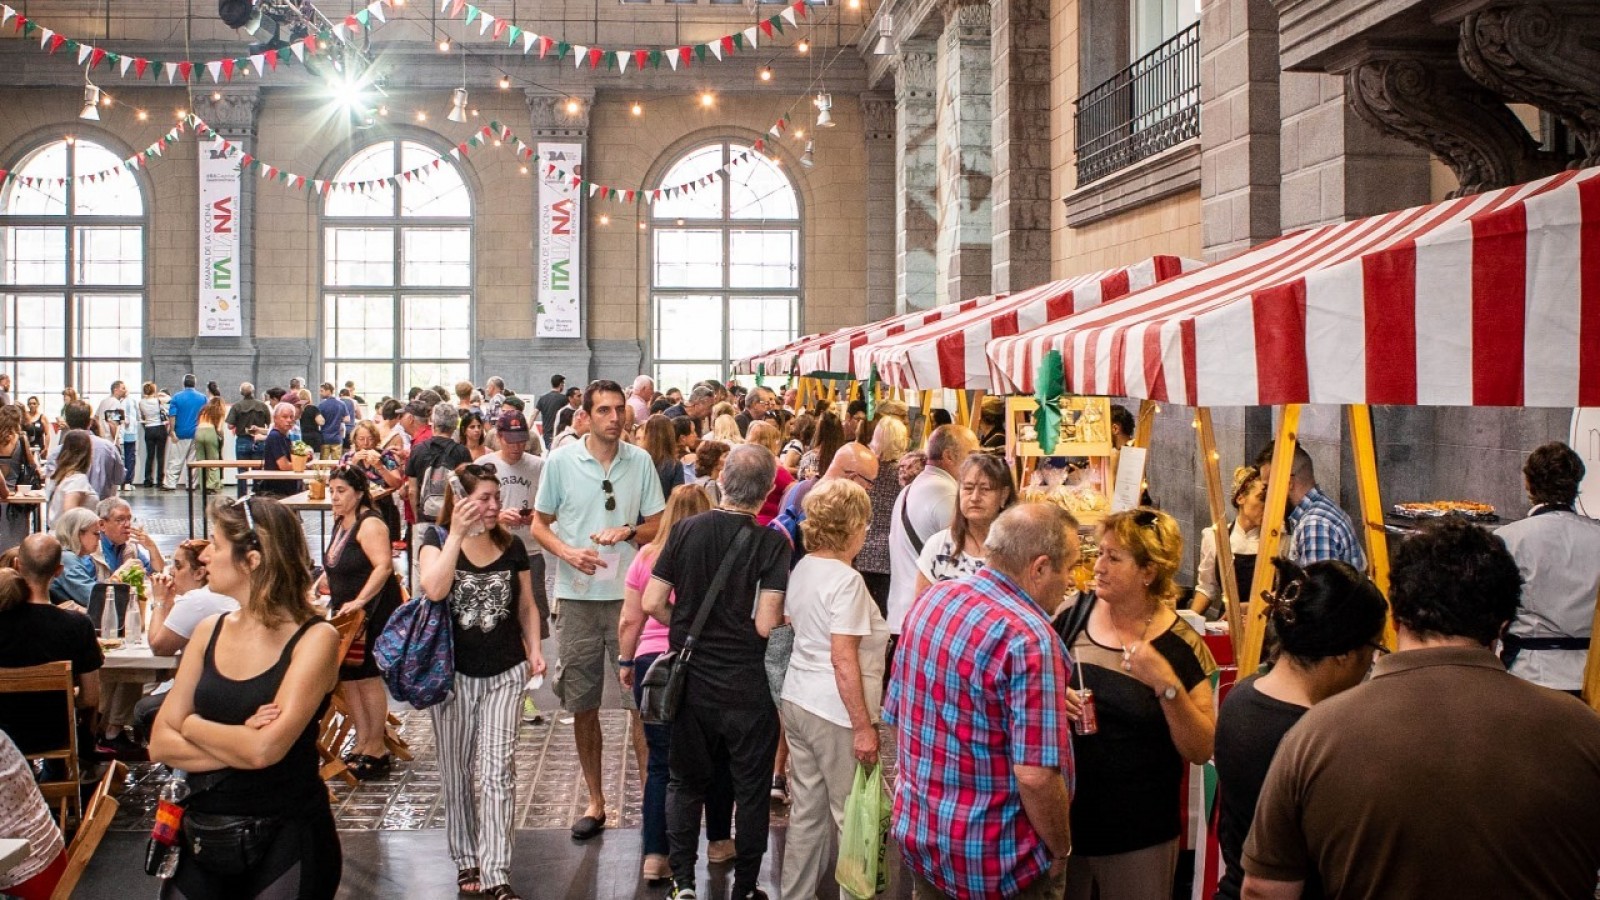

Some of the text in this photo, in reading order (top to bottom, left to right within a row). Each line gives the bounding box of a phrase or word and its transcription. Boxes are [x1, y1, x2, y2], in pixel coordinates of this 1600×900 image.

[549, 151, 566, 161] BA
[205, 235, 211, 244] LA
[214, 197, 231, 289] ITALIANA
[543, 236, 549, 246] LA
[552, 199, 570, 290] ITALIANA
[205, 245, 211, 256] DE
[543, 247, 549, 257] DE
